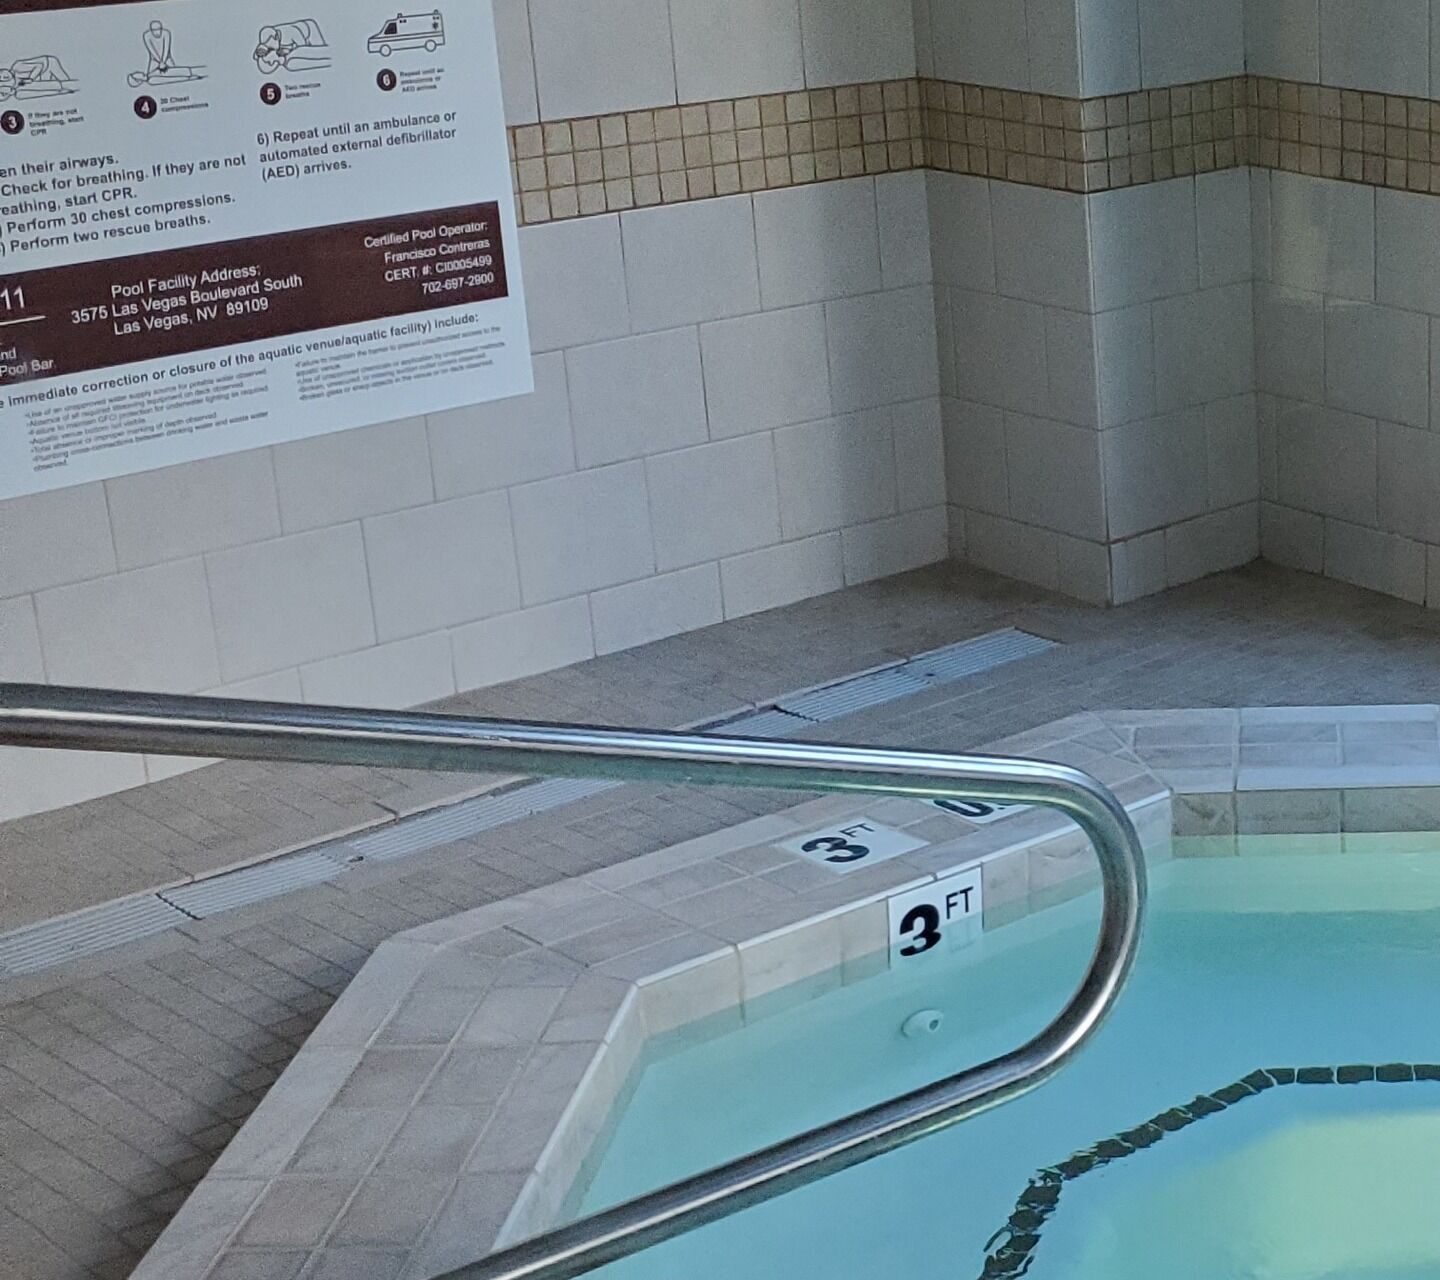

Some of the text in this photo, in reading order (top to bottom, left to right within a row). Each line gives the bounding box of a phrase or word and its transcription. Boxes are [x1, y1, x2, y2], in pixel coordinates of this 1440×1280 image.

[141, 101, 150, 113] 4
[266, 88, 276, 100] 5
[257, 111, 457, 147] 6) Repeat until an ambulance or
[259, 127, 457, 163] automated external defibrillator
[1, 153, 247, 197] Check for breathing. If they are not
[21, 160, 54, 176] their
[59, 154, 119, 172] airways.
[261, 158, 352, 183] (AED) arrives.
[7, 217, 66, 235] Perform
[71, 212, 87, 226] 30
[91, 206, 130, 222] chest
[134, 192, 235, 216] compressions.
[65, 191, 98, 208] start
[101, 186, 138, 202] CPR.
[10, 235, 70, 253] Perform
[74, 230, 99, 244] two
[103, 223, 151, 239] rescue
[155, 214, 211, 232] breaths.
[364, 220, 488, 249] Certified Pool Operator:
[384, 238, 491, 264] Francisco Contreras
[111, 264, 262, 299] Pool Facility Address:
[112, 302, 139, 318] Las
[141, 295, 188, 313] Vegas
[190, 281, 260, 305] Boulevard
[263, 273, 303, 292] South
[113, 297, 269, 336] Las Vegas, NV 89109
[8, 384, 78, 407] immediate
[82, 372, 148, 393] correction
[152, 368, 166, 381] or
[170, 360, 216, 378] closure
[220, 355, 232, 368] of
[236, 352, 255, 366] the
[258, 344, 302, 362] aquatic
[305, 330, 387, 353] venue/aquatic
[390, 319, 432, 338] facility)
[434, 313, 479, 330] include:
[801, 822, 874, 863] 3 FT
[899, 886, 974, 957] 3 FT
